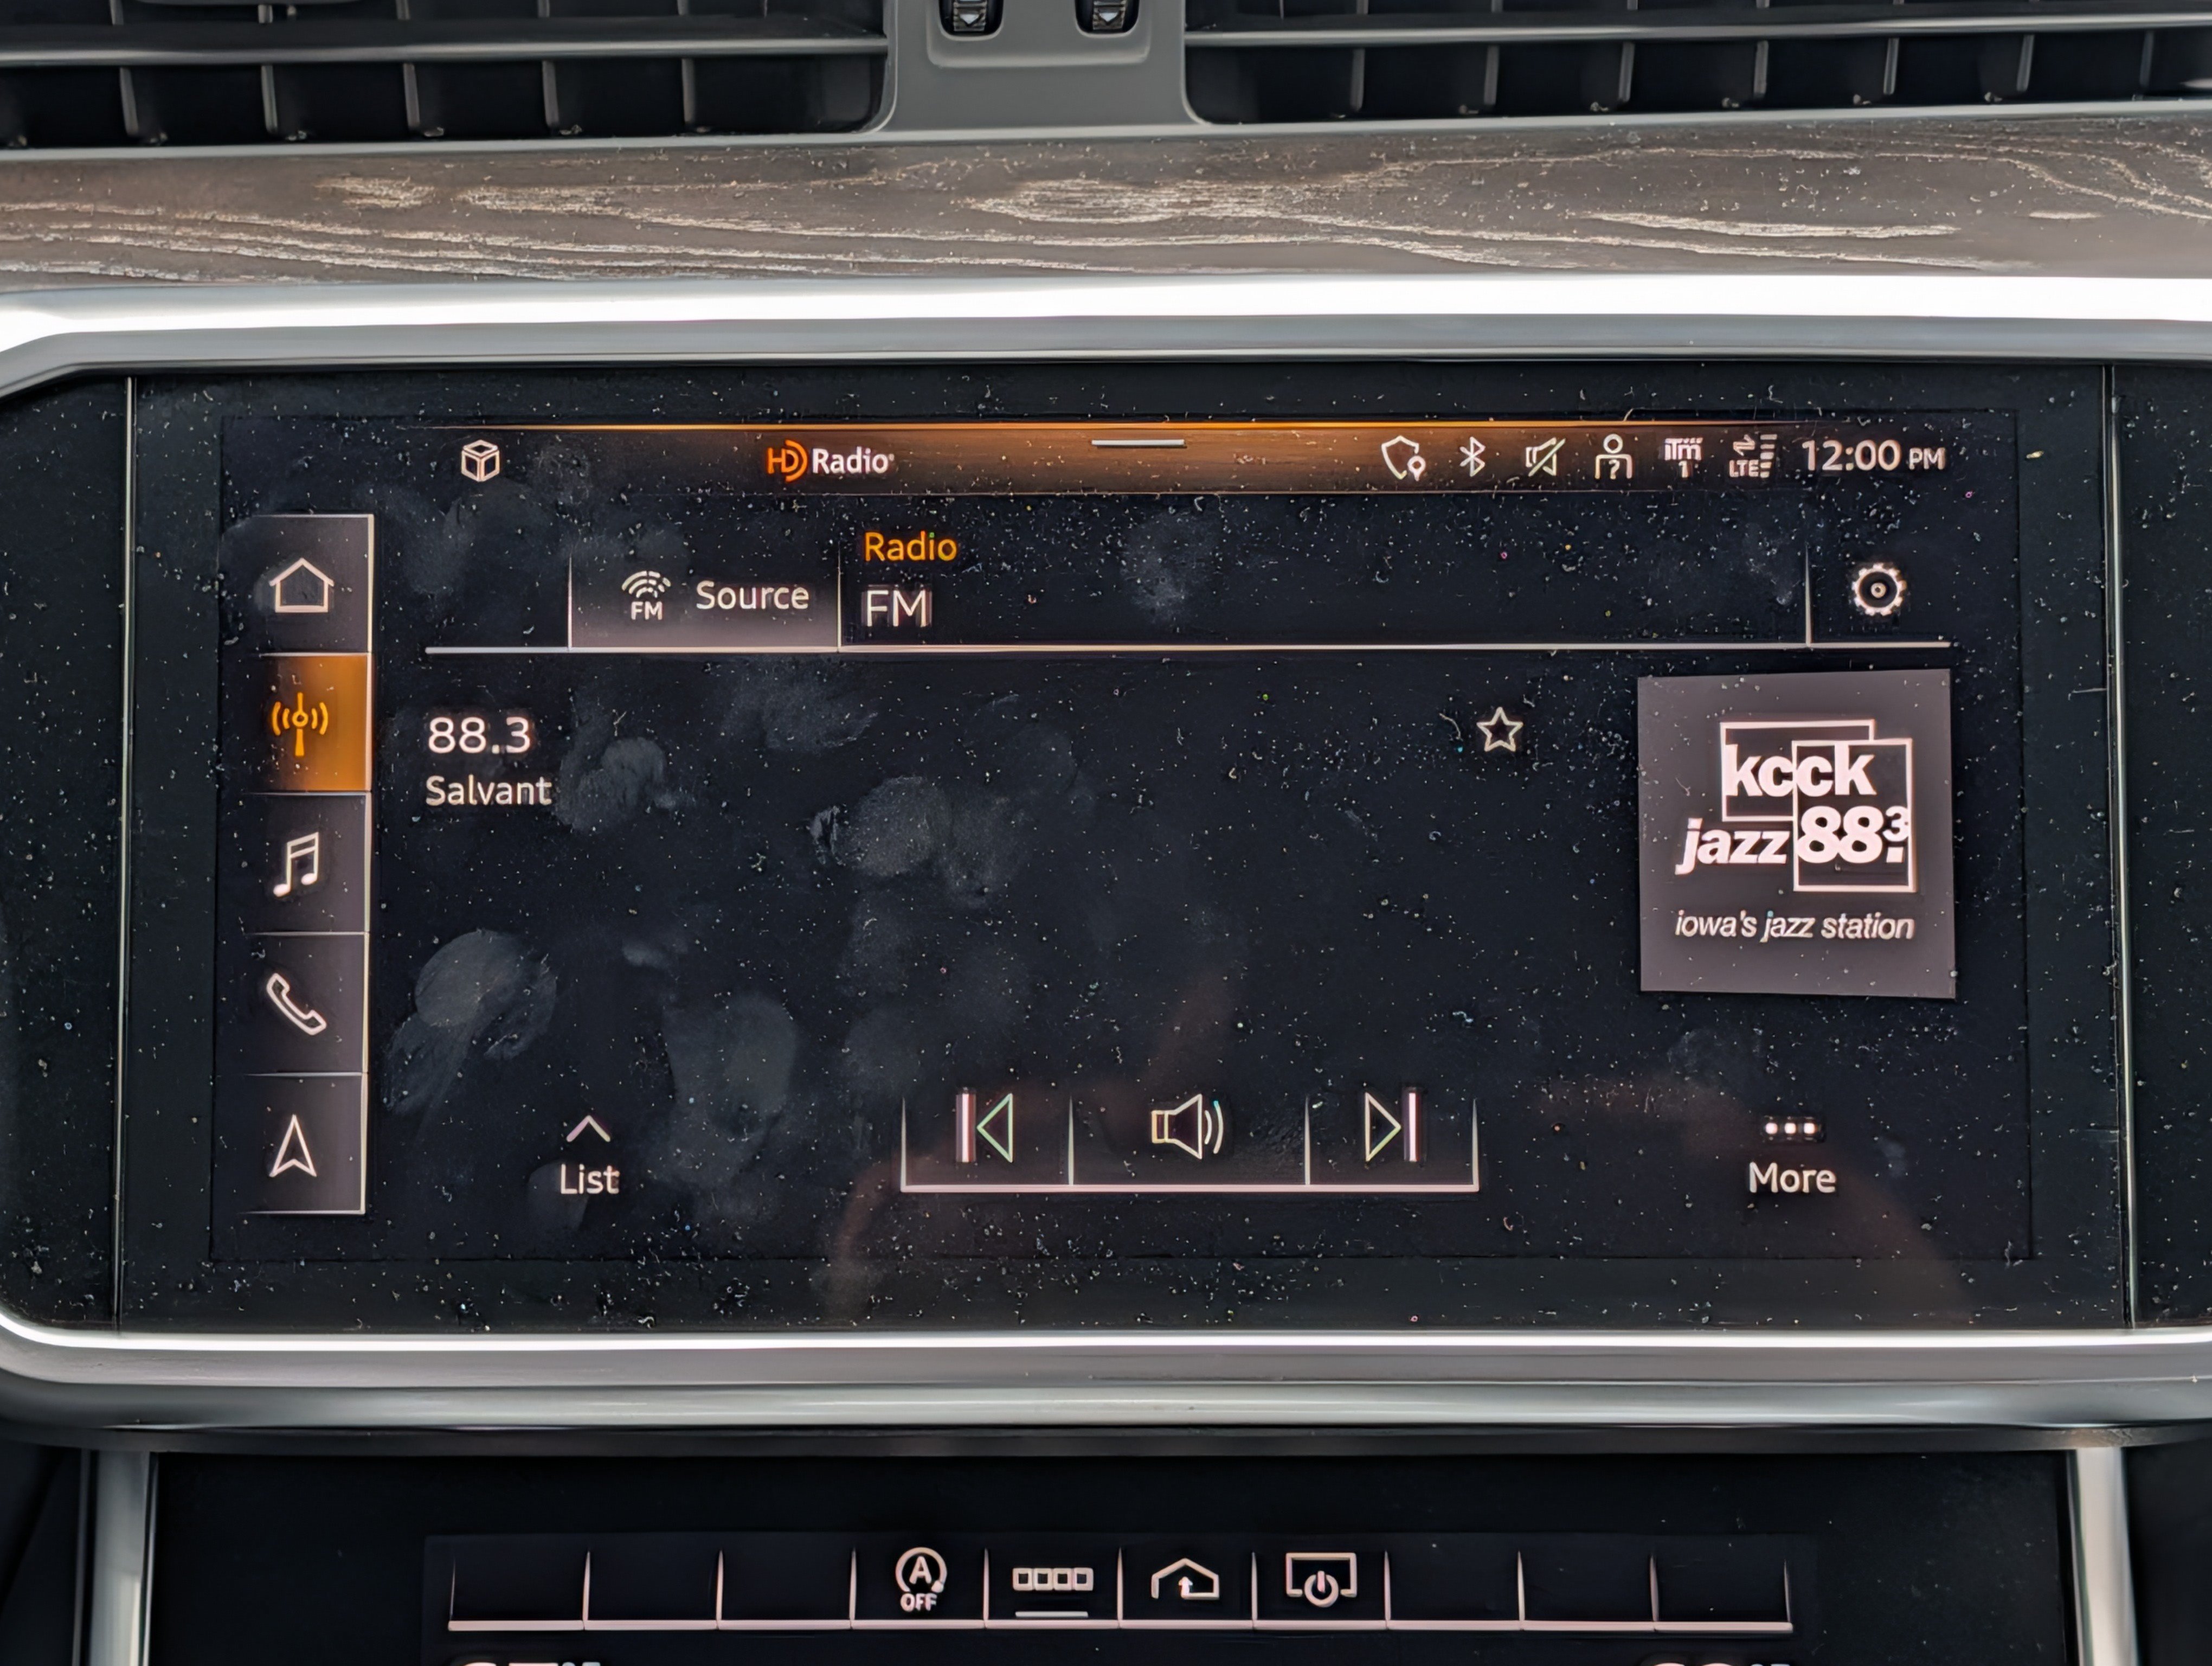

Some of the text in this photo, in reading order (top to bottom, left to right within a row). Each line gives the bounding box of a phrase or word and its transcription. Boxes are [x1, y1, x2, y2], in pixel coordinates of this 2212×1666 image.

[1729, 459, 1759, 478] LTE
[1802, 439, 1945, 472] 12:00 PM
[864, 532, 957, 561] Radio
[631, 601, 663, 620] FM
[696, 581, 809, 610] Source
[866, 590, 927, 627] FM
[428, 717, 531, 754] 88.3
[1725, 743, 1877, 797] kcck
[426, 775, 552, 806] Salvant
[1675, 818, 1790, 875] jazz
[1675, 910, 1915, 943] iowa's jazz station
[561, 1164, 619, 1194] List
[1749, 1162, 1837, 1194] More
[901, 1593, 937, 1612] OFF
